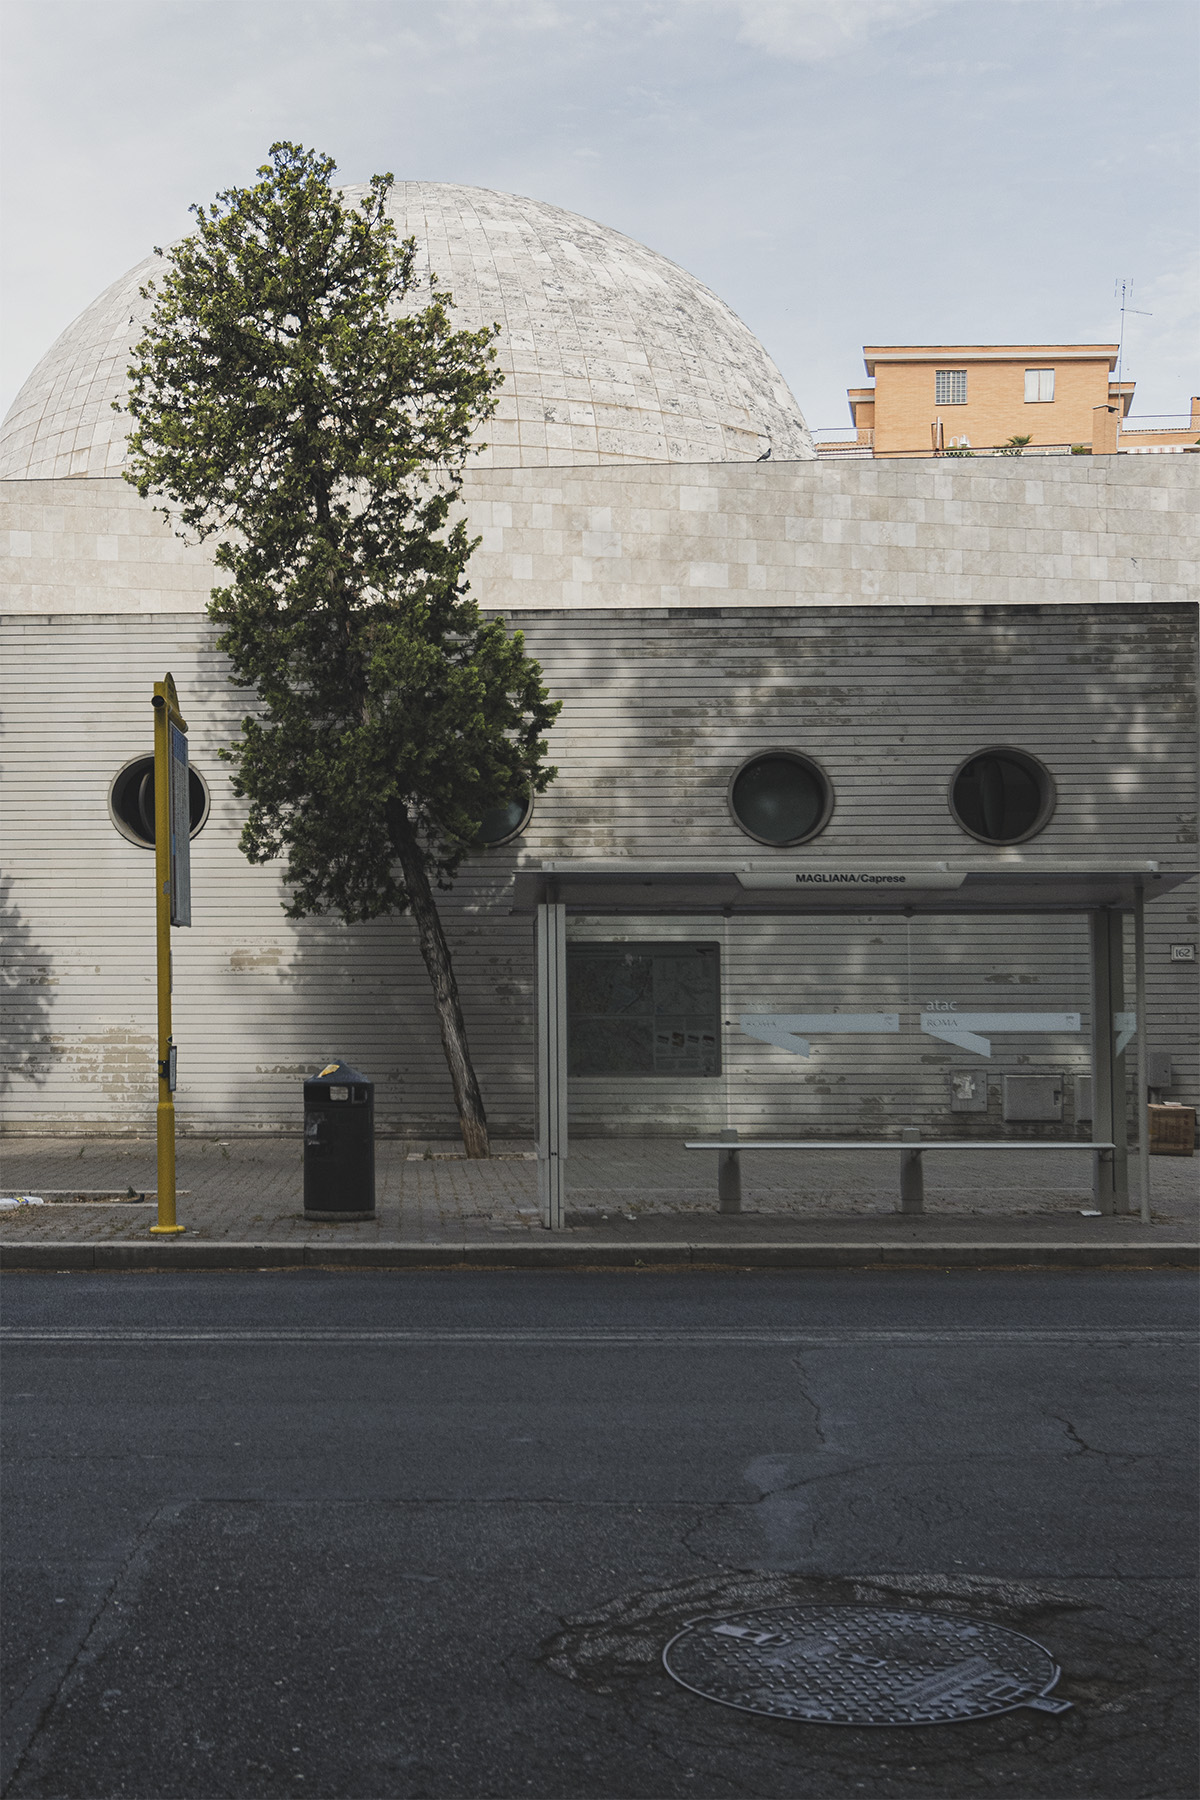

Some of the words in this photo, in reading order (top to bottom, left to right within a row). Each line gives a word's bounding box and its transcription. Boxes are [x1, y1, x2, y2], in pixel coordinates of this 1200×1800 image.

[795, 873, 906, 884] MAGLIANA/Caprese
[1175, 948, 1191, 958] 162
[926, 1000, 958, 1011] atac
[926, 1018, 958, 1027] ROMA
